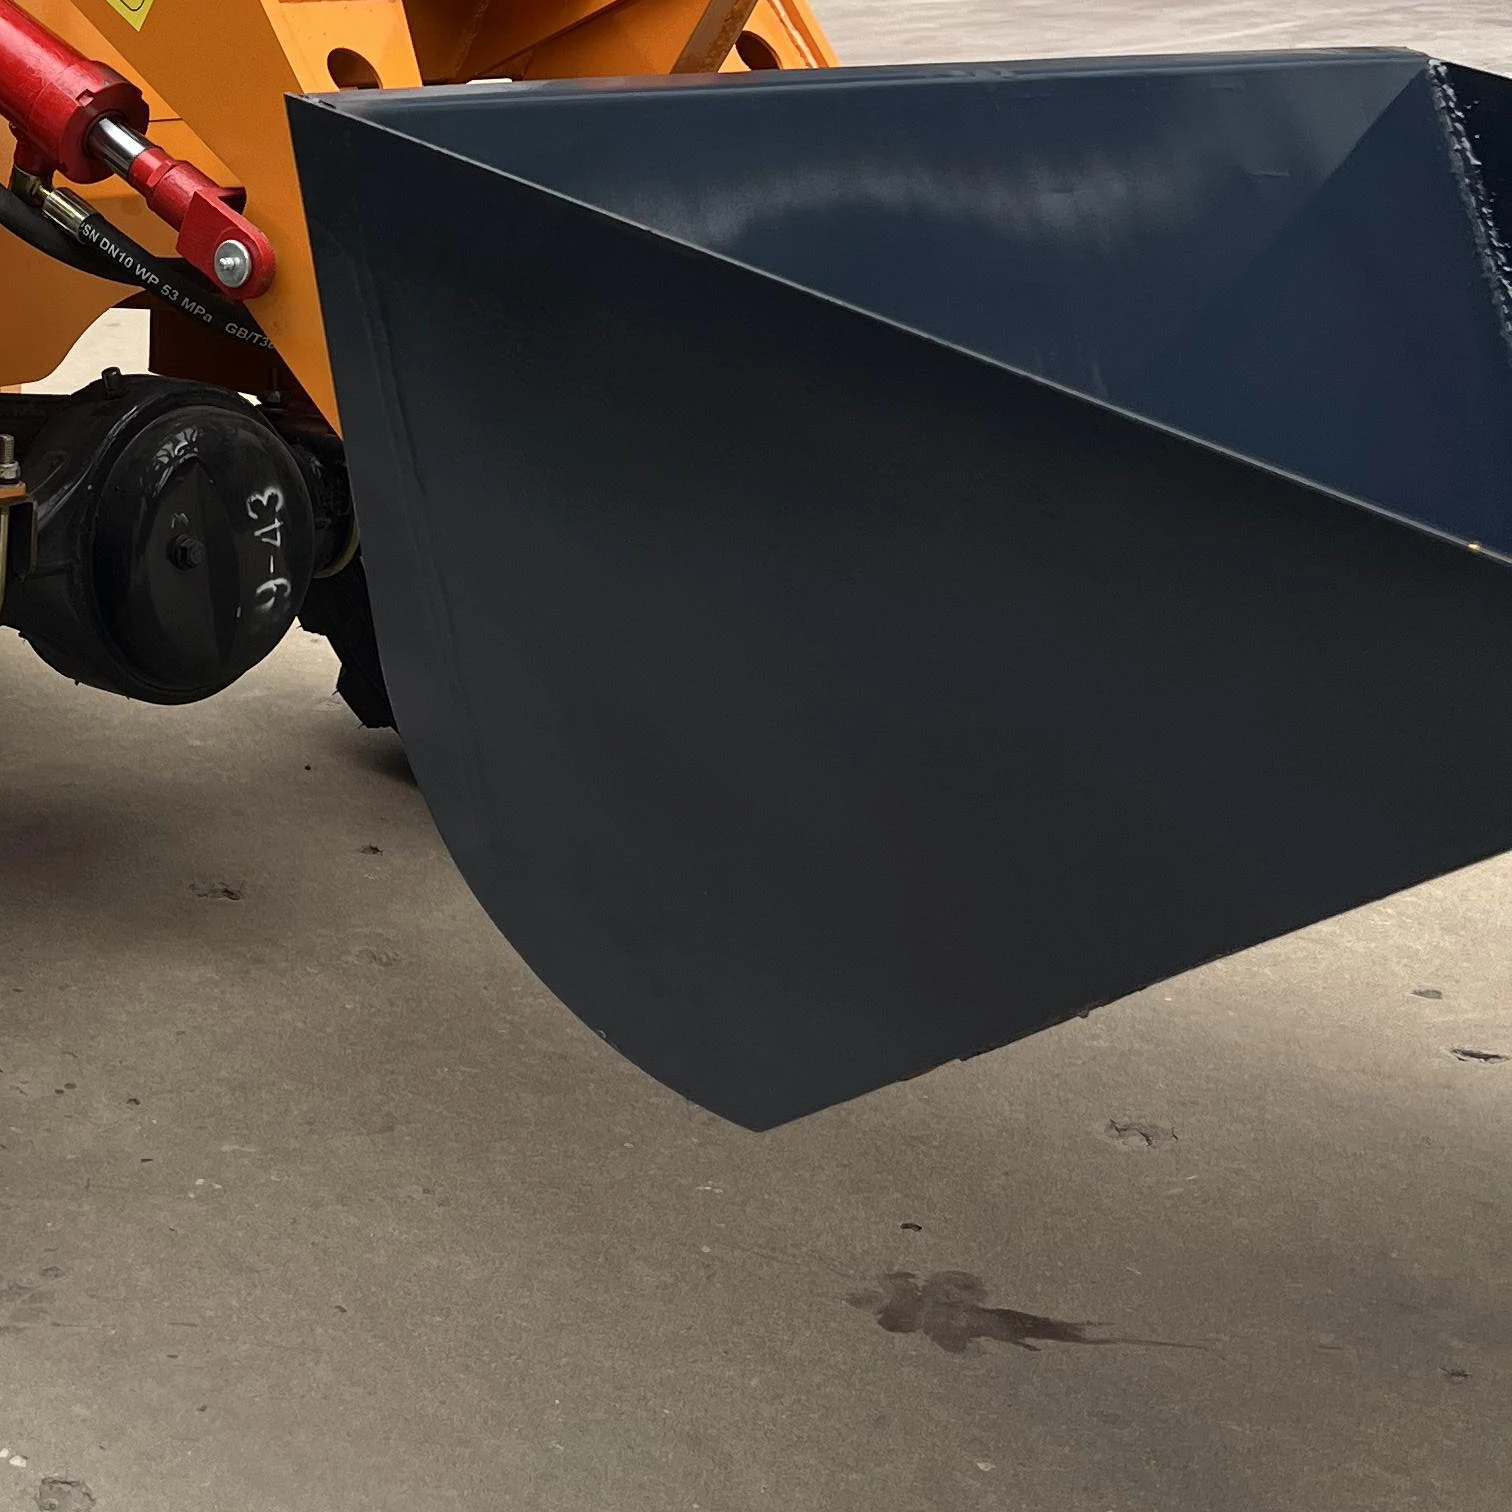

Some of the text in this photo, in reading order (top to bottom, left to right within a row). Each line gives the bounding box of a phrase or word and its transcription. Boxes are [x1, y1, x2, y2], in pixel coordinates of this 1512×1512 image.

[80, 222, 98, 243] SN
[100, 239, 134, 270] DN10
[135, 264, 160, 286] WP
[160, 284, 180, 301] 53
[181, 296, 214, 323] MPa
